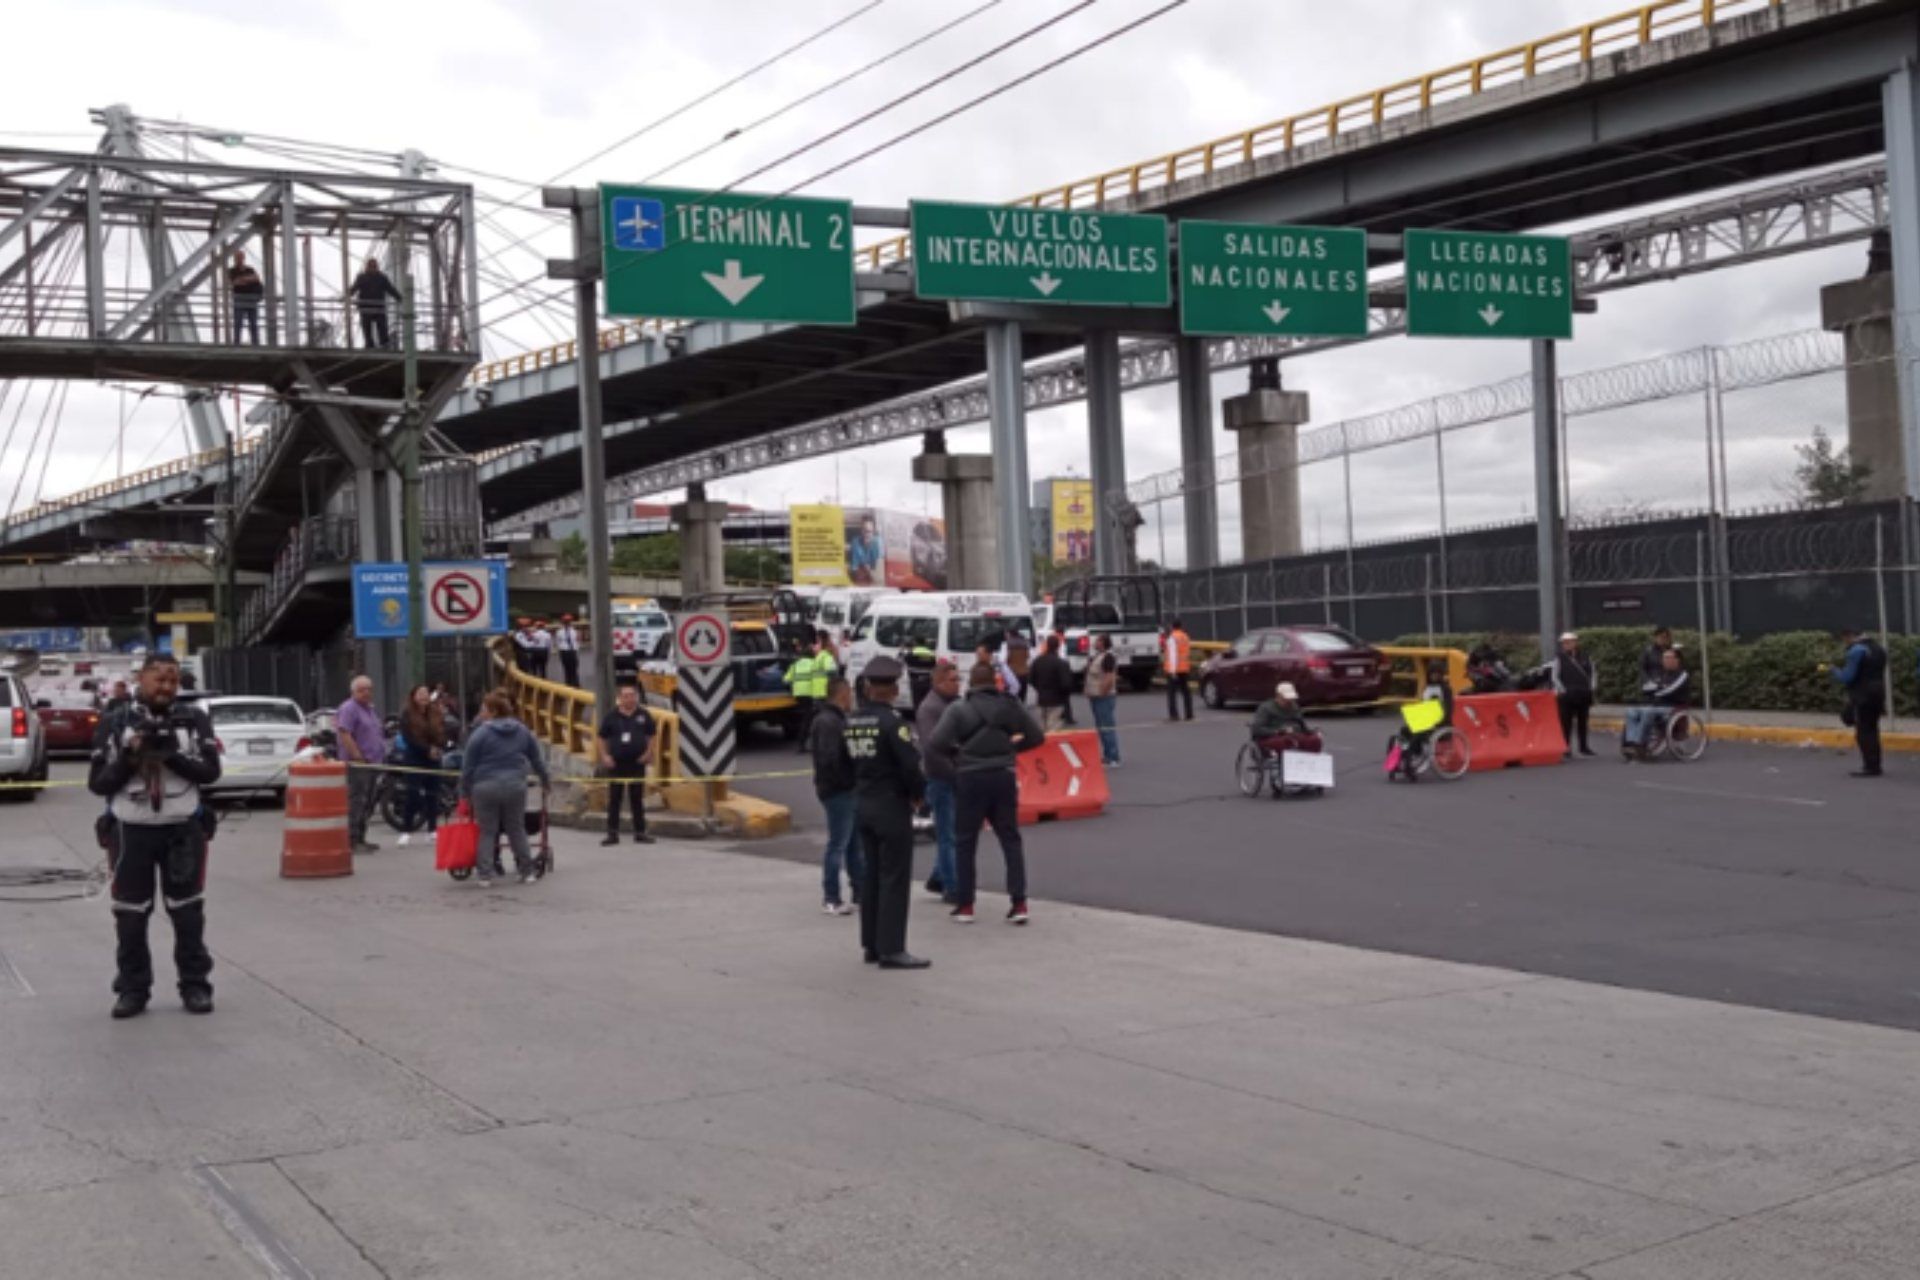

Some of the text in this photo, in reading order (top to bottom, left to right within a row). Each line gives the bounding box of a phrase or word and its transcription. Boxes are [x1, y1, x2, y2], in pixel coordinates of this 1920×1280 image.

[675, 203, 844, 250] TERMINAL 2
[988, 211, 1102, 241] VUELOS
[928, 237, 1157, 272] INTERNACIONALES
[1223, 233, 1327, 258] SALIDAS
[1431, 240, 1547, 265] LLEGADAS
[1191, 265, 1359, 292] NACIONALES
[1415, 272, 1564, 297] NACIONALES
